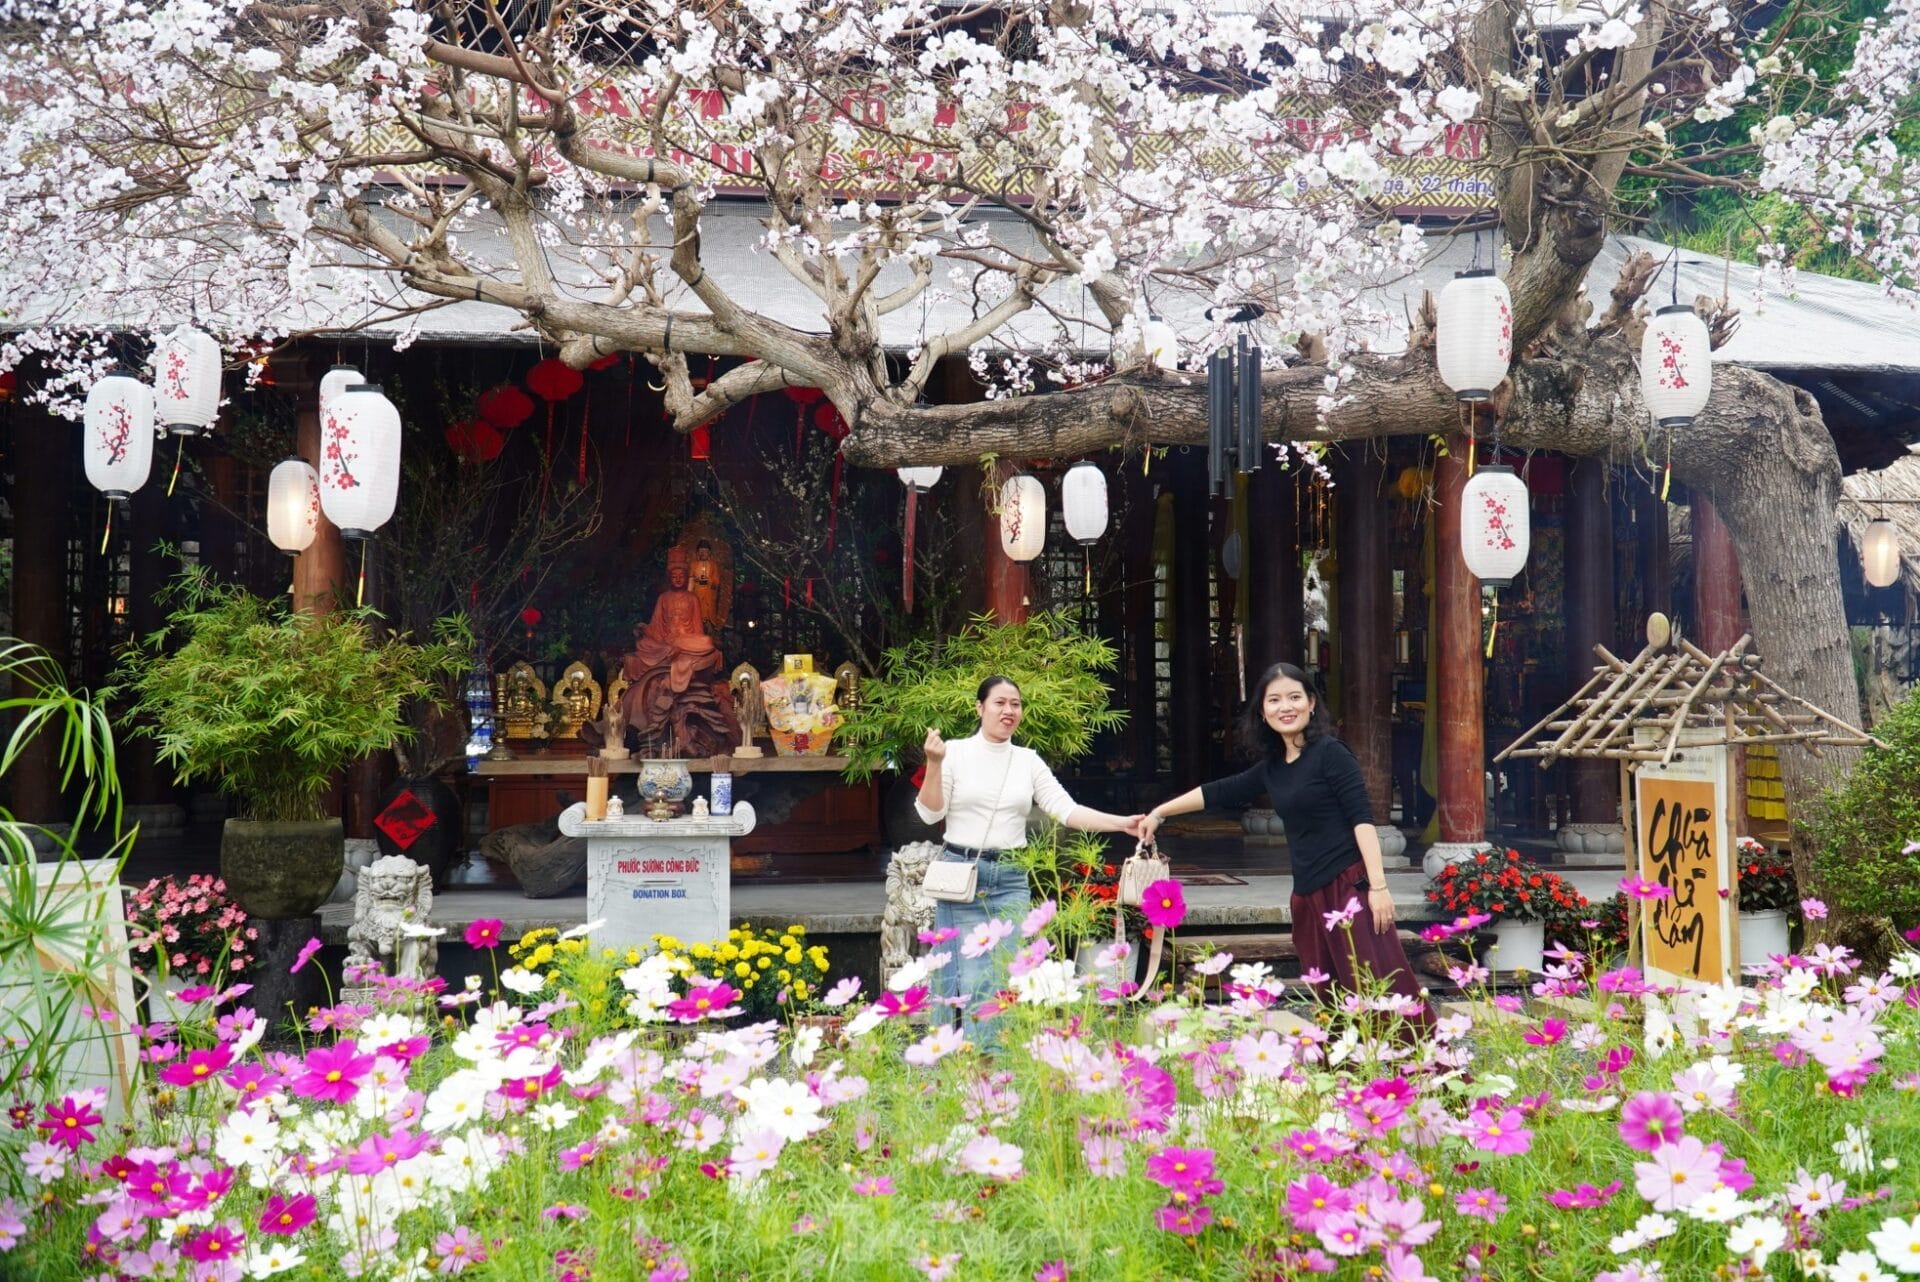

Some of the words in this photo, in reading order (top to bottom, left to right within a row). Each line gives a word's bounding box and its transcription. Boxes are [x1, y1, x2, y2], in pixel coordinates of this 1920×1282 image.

[1421, 177, 1441, 192] 22
[617, 857, 641, 873] PHƯỚC
[666, 856, 684, 872] CÔNG
[685, 856, 700, 872] ĐỨC
[633, 889, 670, 899] DONATION
[671, 889, 687, 898] BOX
